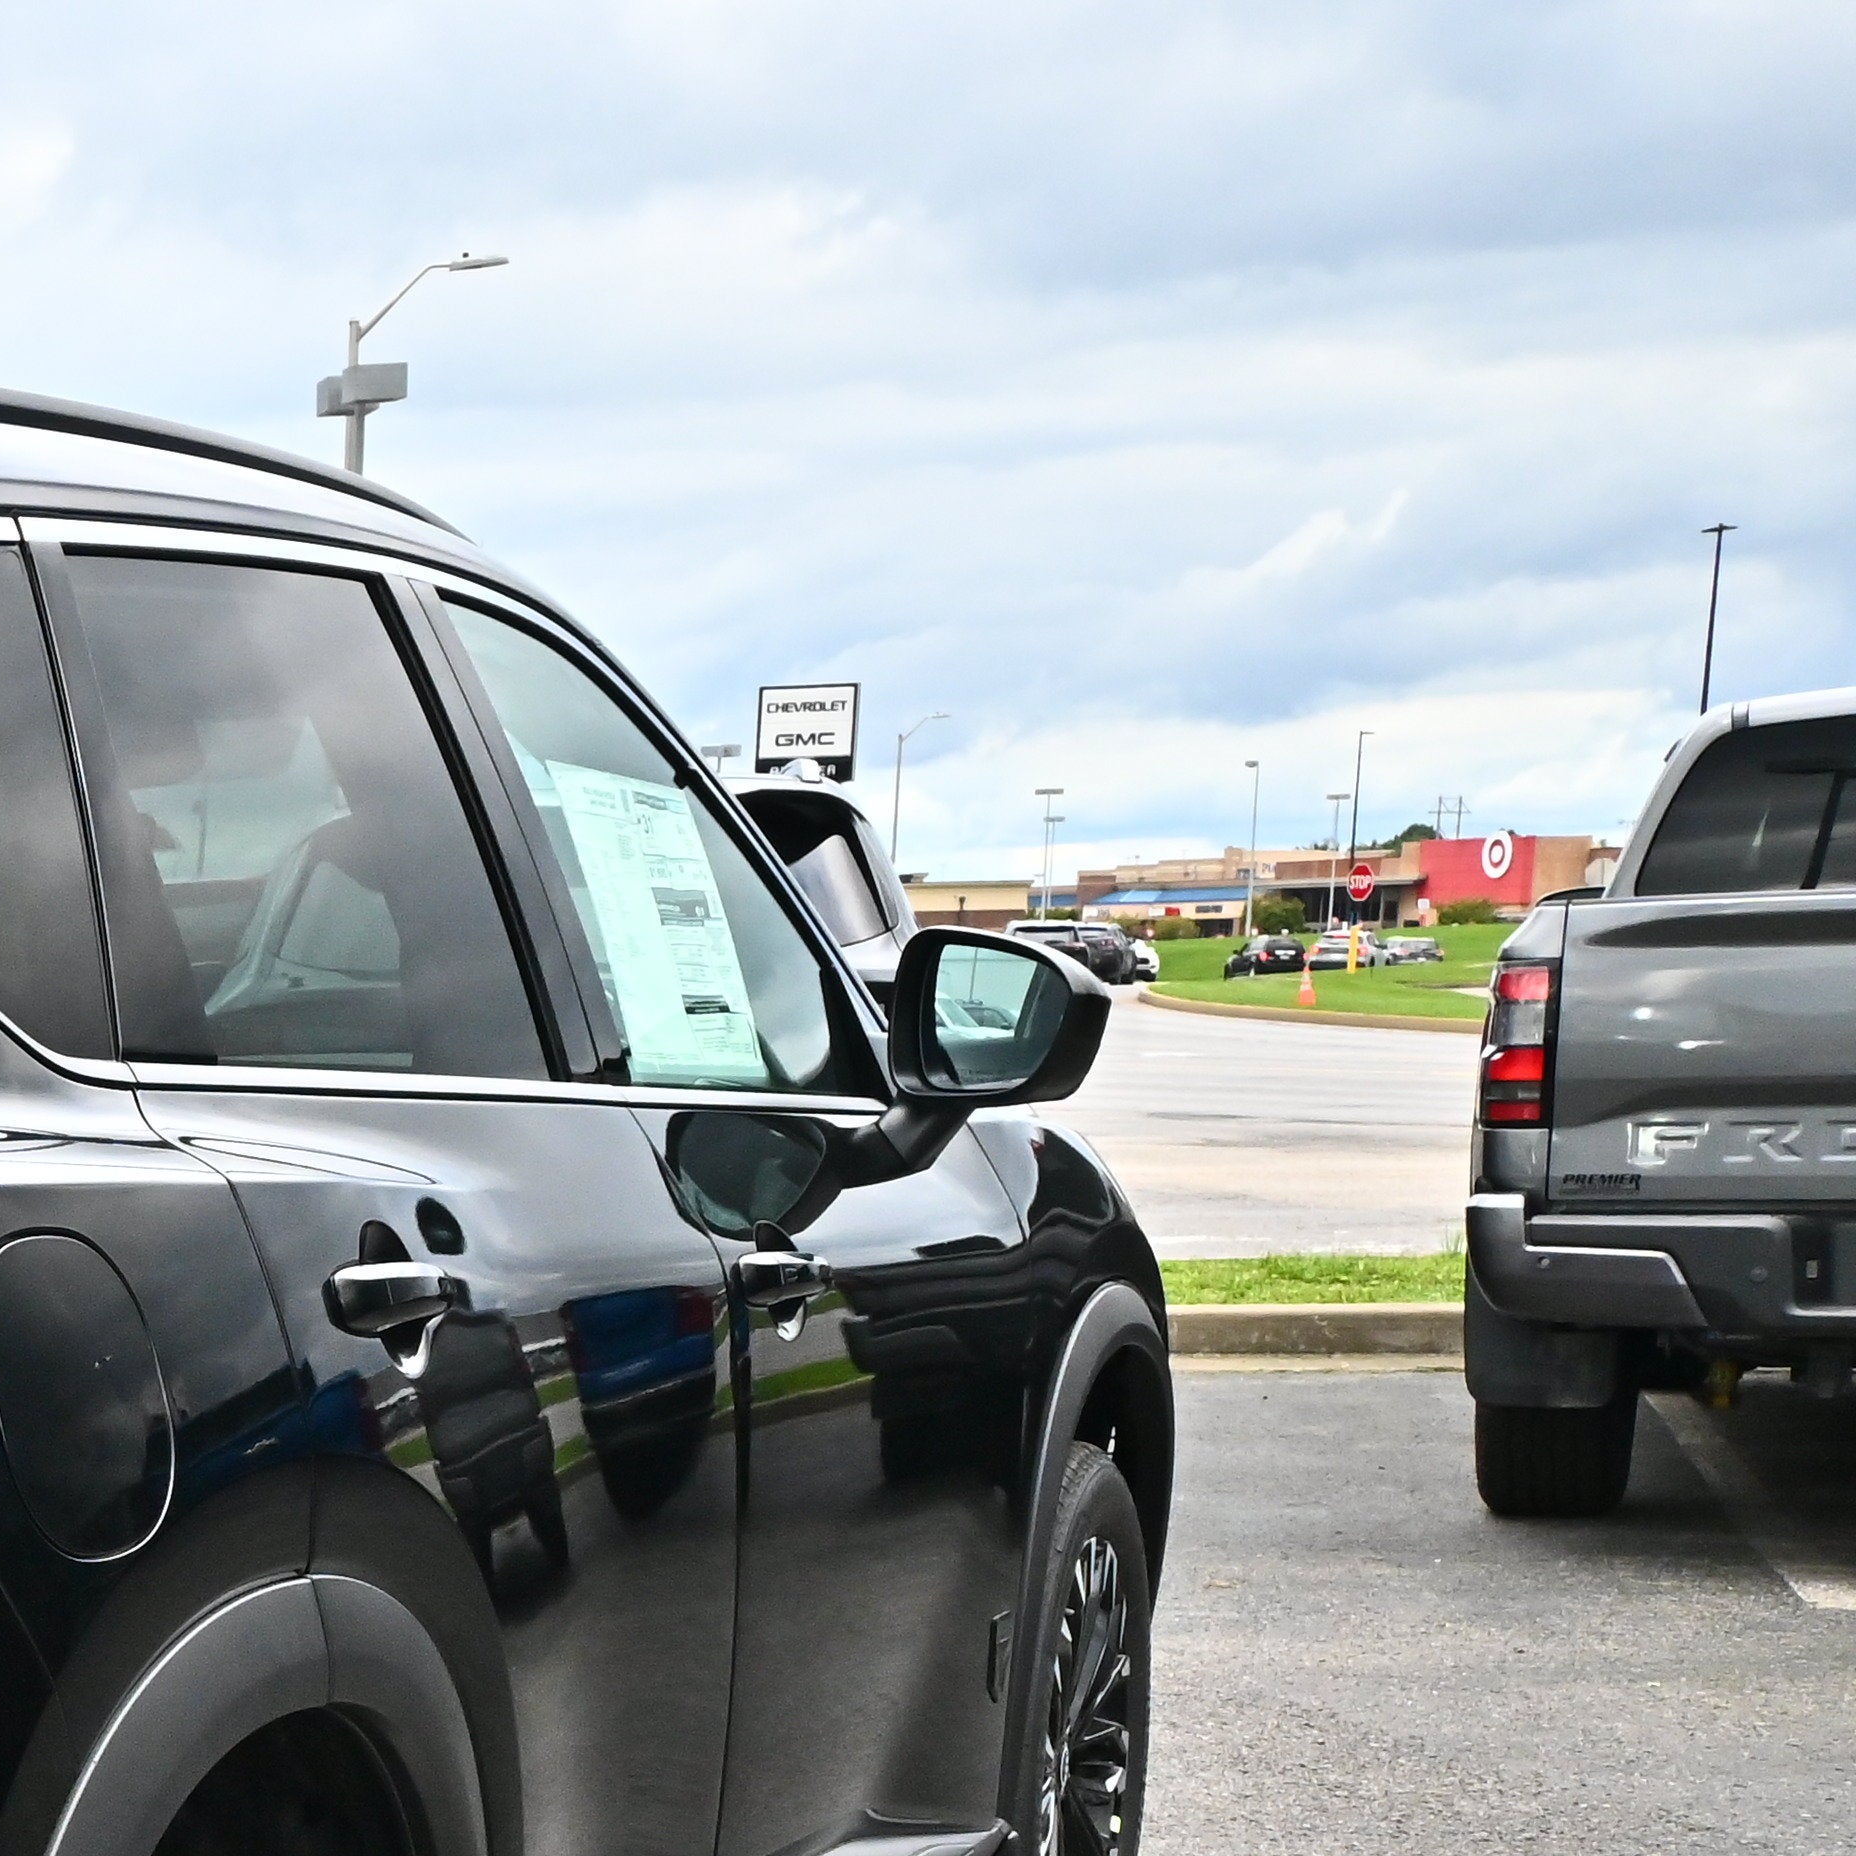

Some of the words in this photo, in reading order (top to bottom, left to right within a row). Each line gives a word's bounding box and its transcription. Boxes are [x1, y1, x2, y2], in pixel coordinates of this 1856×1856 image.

[767, 700, 848, 714] CHEVROLET
[775, 732, 835, 747] GMC
[1349, 875, 1372, 890] STOP
[1562, 1173, 1642, 1187] PREMIER
